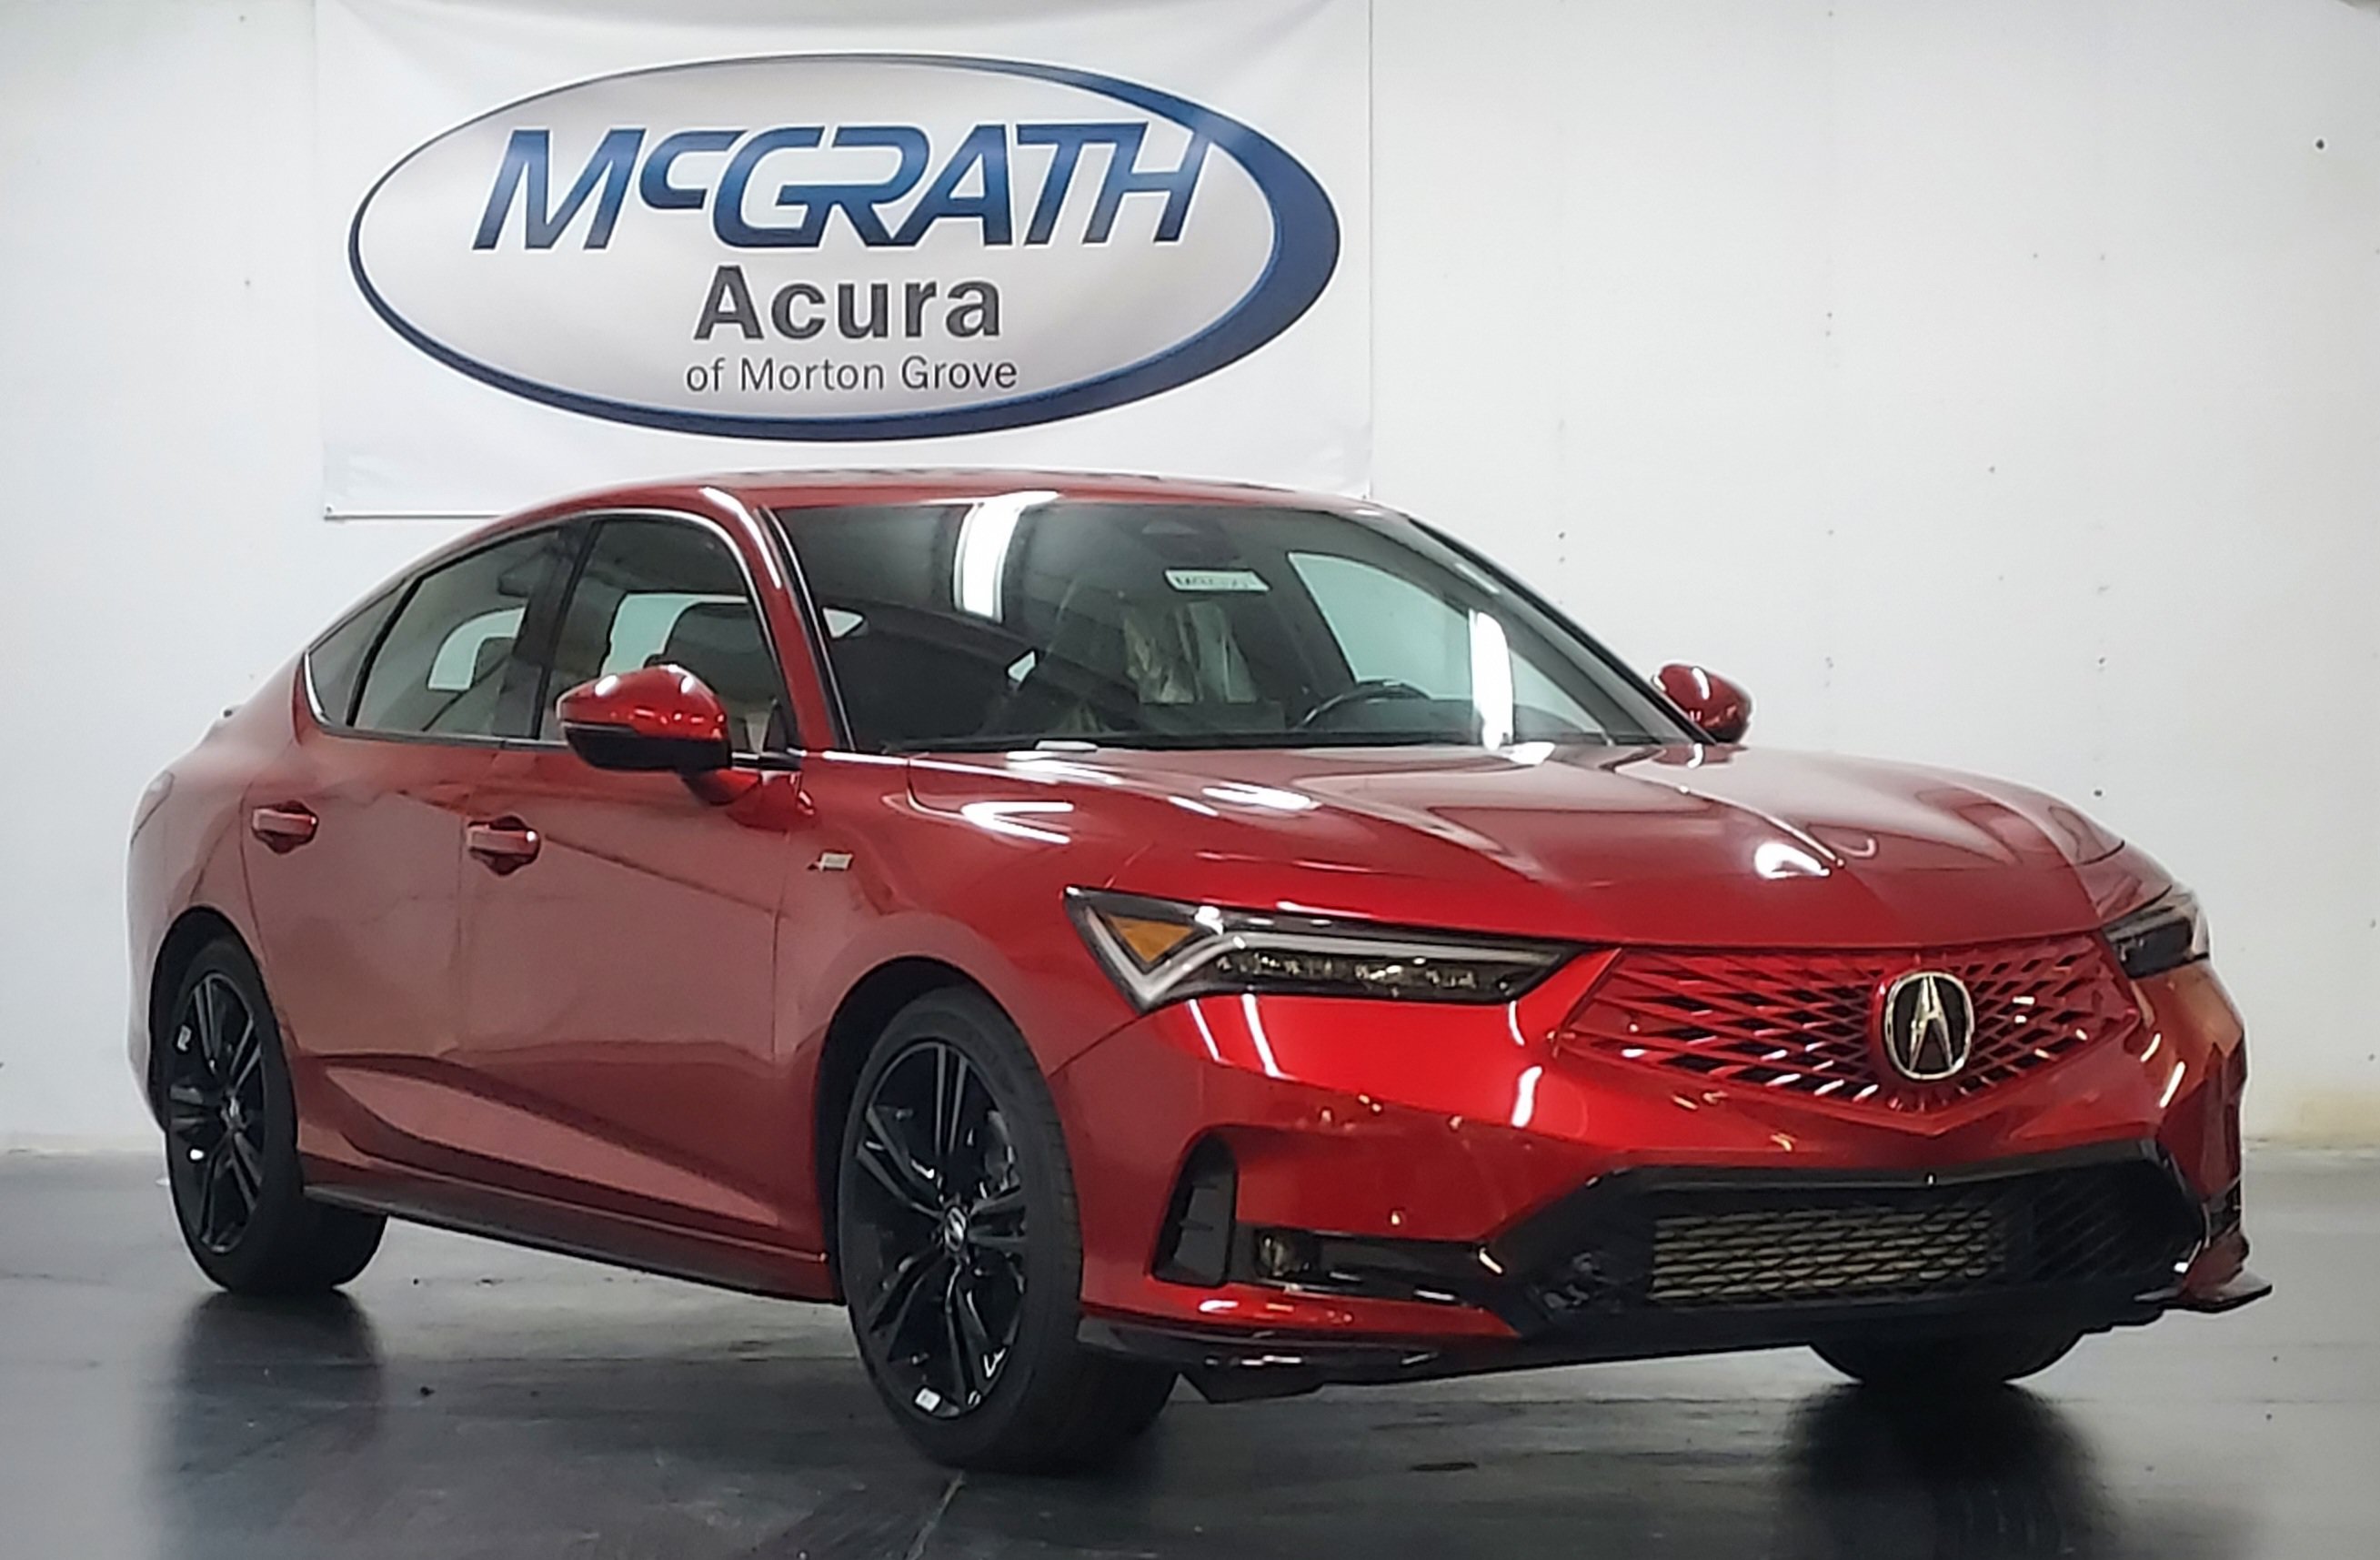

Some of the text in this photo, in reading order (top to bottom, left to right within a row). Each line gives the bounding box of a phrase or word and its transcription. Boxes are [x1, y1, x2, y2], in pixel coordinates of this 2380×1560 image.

[694, 265, 1000, 340] Acura
[686, 355, 1018, 392] of Morton Grove
